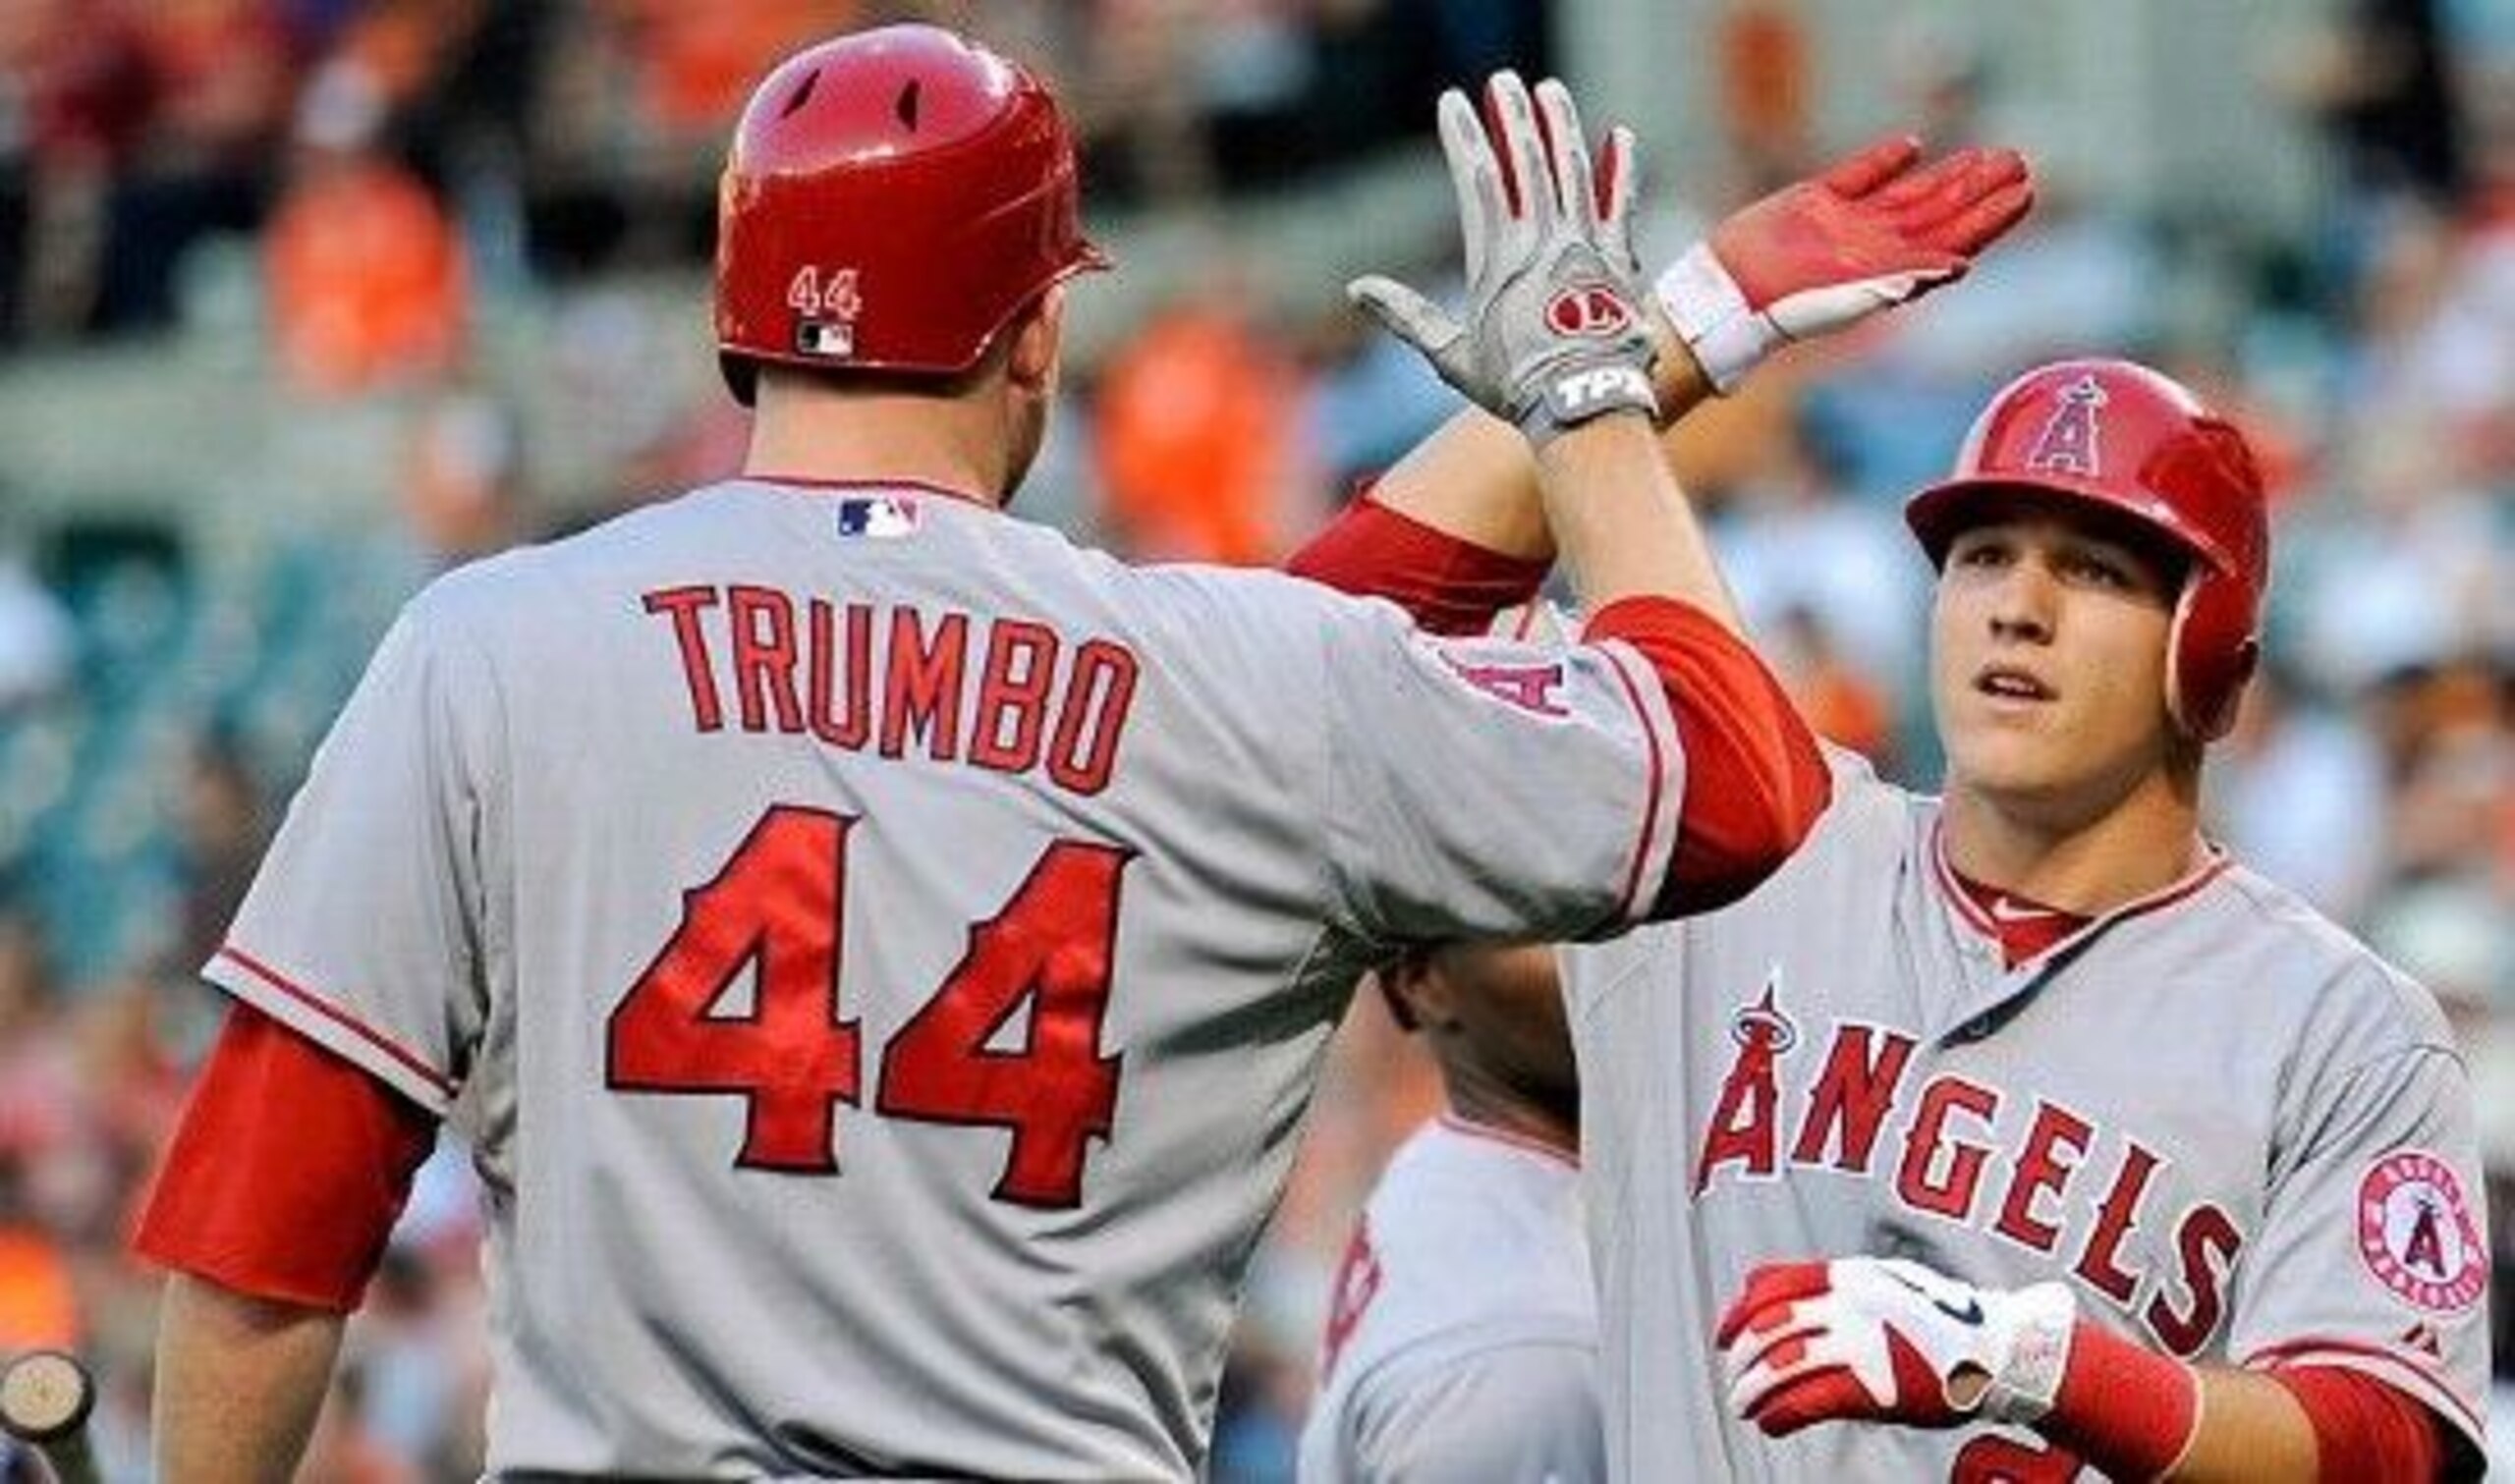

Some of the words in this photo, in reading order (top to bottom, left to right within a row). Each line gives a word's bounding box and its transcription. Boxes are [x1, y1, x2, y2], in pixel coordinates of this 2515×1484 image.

[787, 264, 863, 320] 44
[2026, 373, 2108, 476] A
[642, 584, 1140, 797] TRUMBO
[605, 802, 1146, 1209] 44
[1690, 972, 2244, 1358] ANGELS
